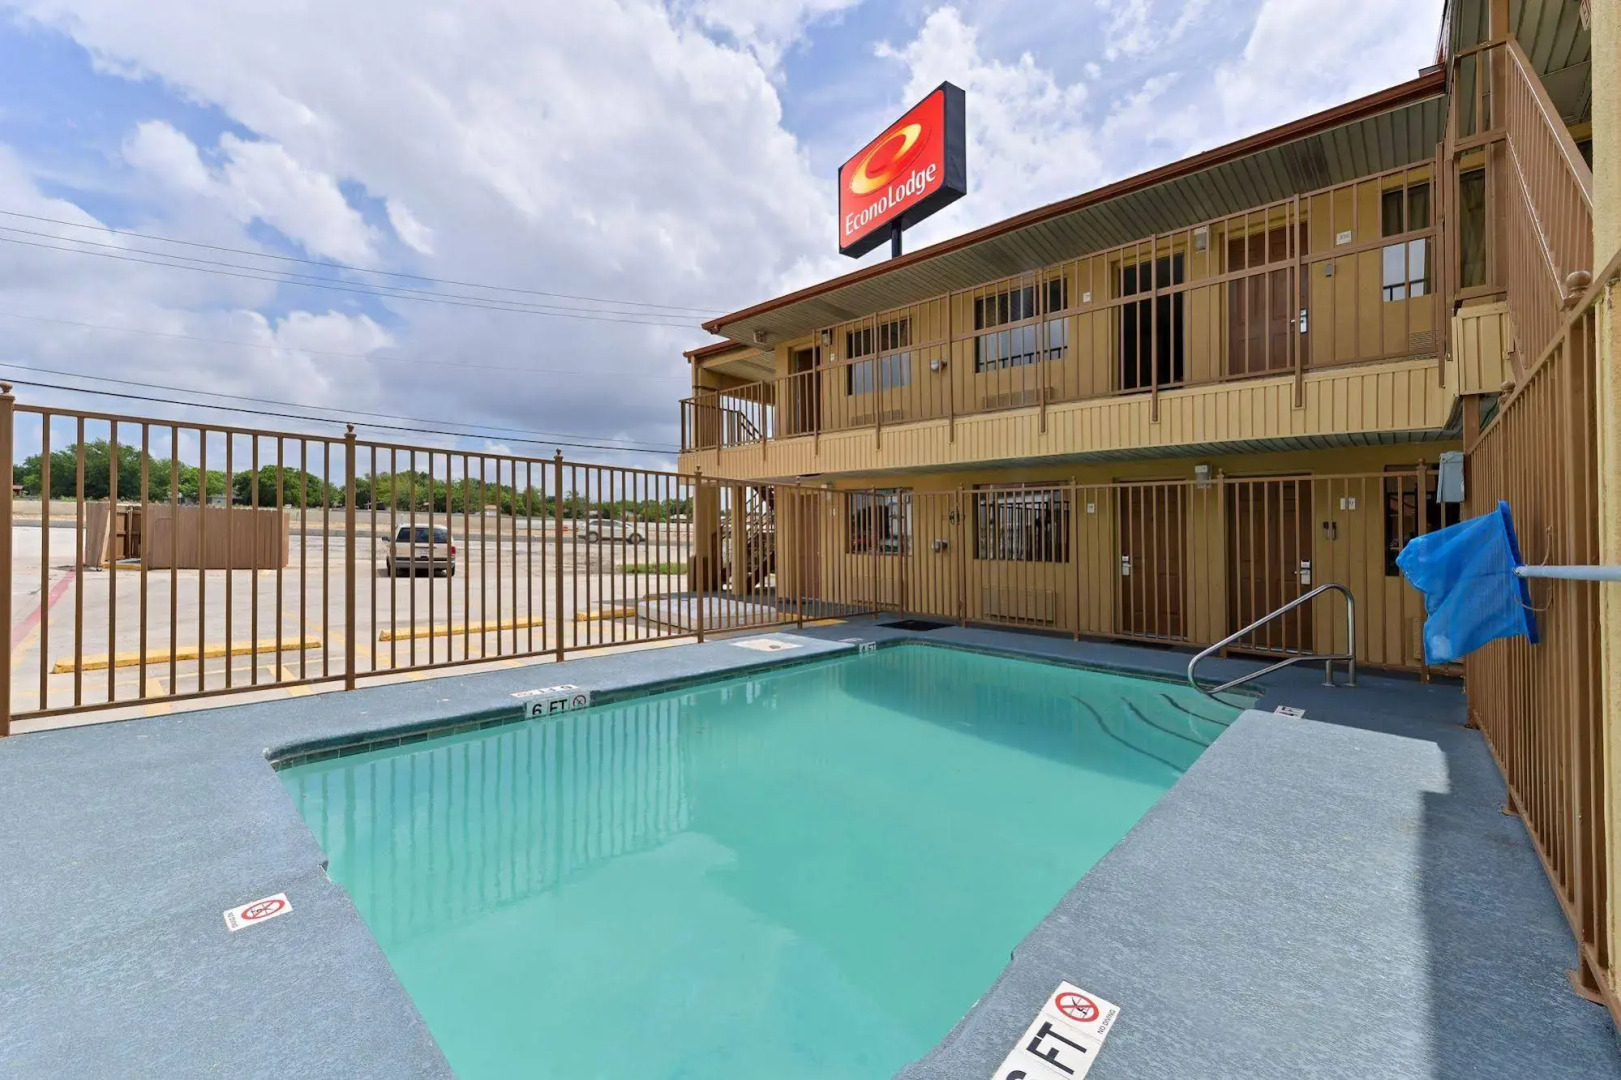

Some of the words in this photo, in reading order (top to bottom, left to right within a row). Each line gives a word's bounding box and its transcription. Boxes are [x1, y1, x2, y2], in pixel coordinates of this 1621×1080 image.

[845, 163, 937, 236] EconoLodge
[532, 703, 543, 715] 6
[549, 699, 568, 713] FT
[1097, 1025, 1106, 1035] NO
[1102, 1009, 1116, 1026] DIVING
[1026, 1021, 1088, 1075] FT
